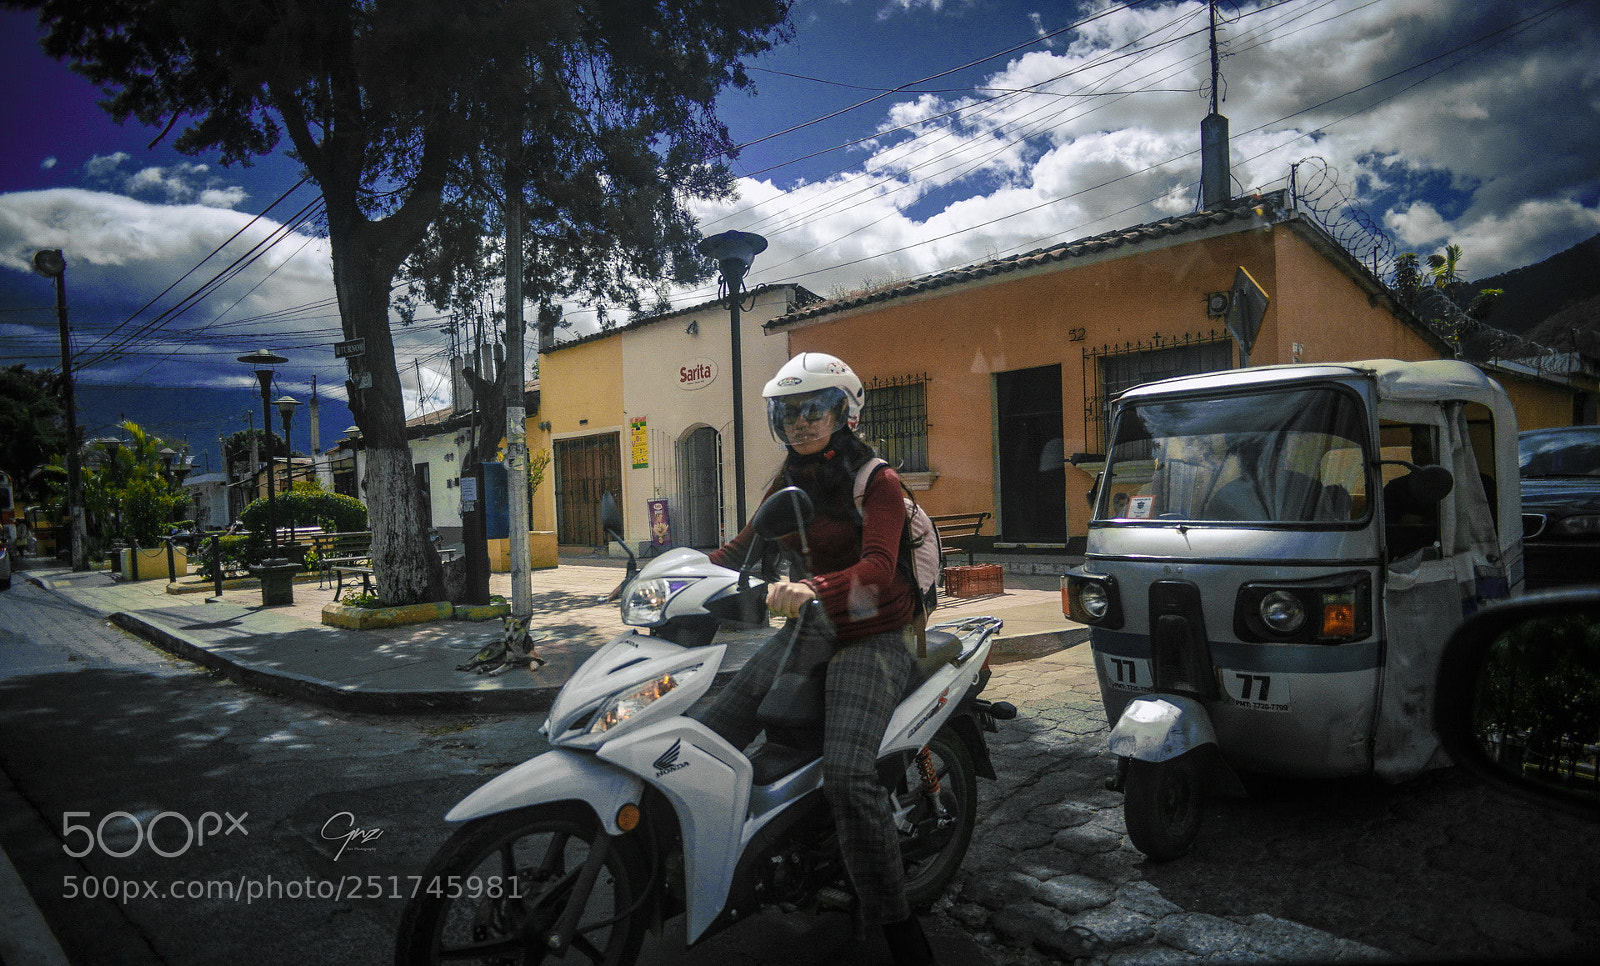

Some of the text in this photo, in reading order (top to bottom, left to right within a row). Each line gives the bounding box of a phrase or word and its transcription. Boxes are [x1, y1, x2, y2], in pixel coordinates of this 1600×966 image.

[1069, 328, 1086, 342] 52
[680, 364, 711, 383] Sarita
[1110, 657, 1136, 684] 77
[1235, 673, 1271, 701] 77
[656, 761, 690, 778] HONDA
